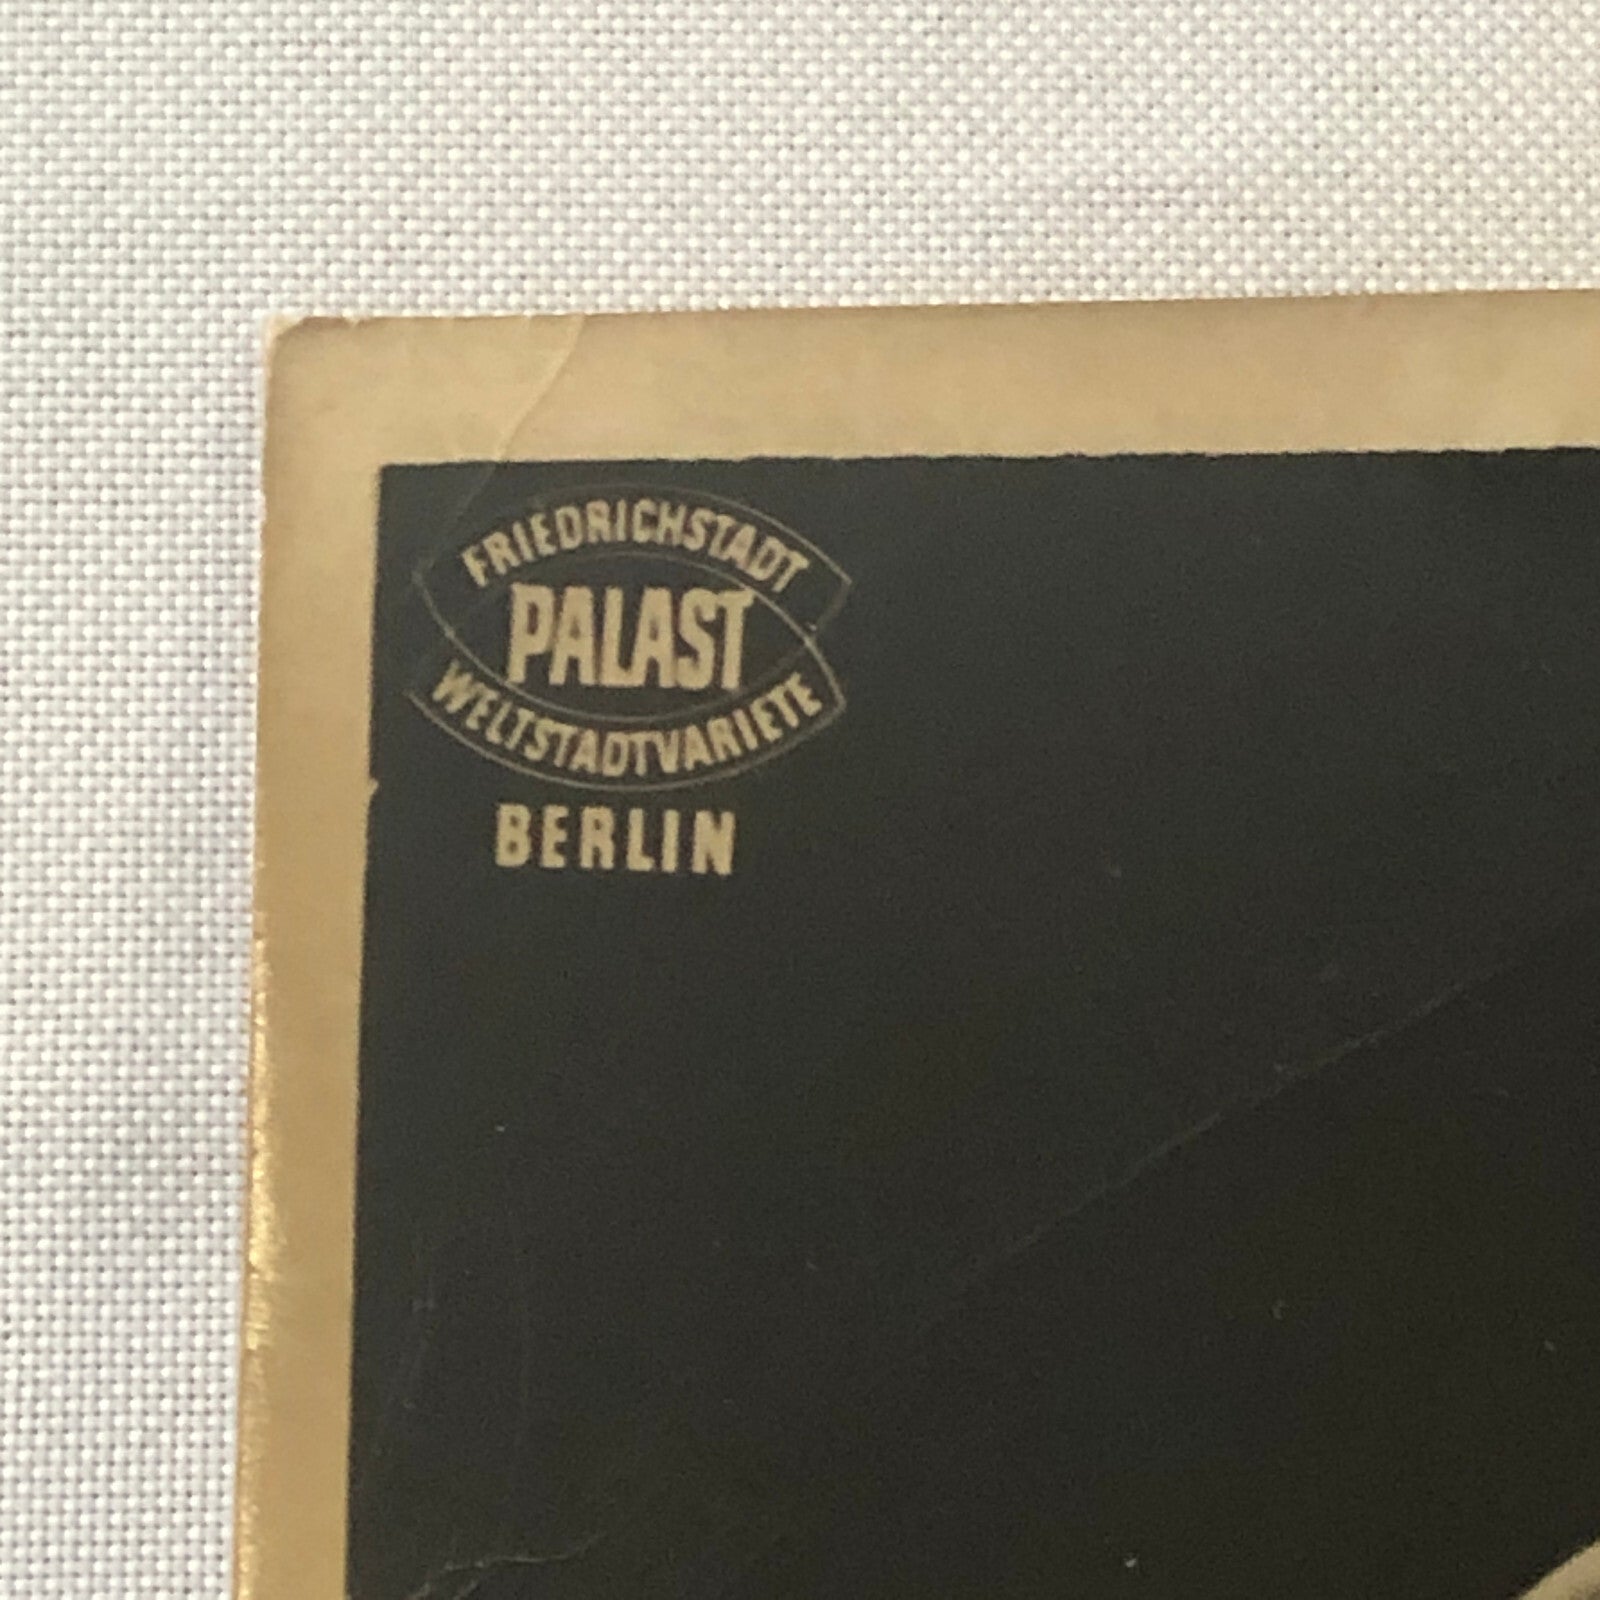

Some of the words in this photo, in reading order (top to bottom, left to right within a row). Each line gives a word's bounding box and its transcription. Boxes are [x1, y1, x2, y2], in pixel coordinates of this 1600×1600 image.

[460, 498, 810, 593] FRIEDRICHSTADT
[506, 582, 755, 691] PALAST
[494, 803, 737, 876] BERLIN
